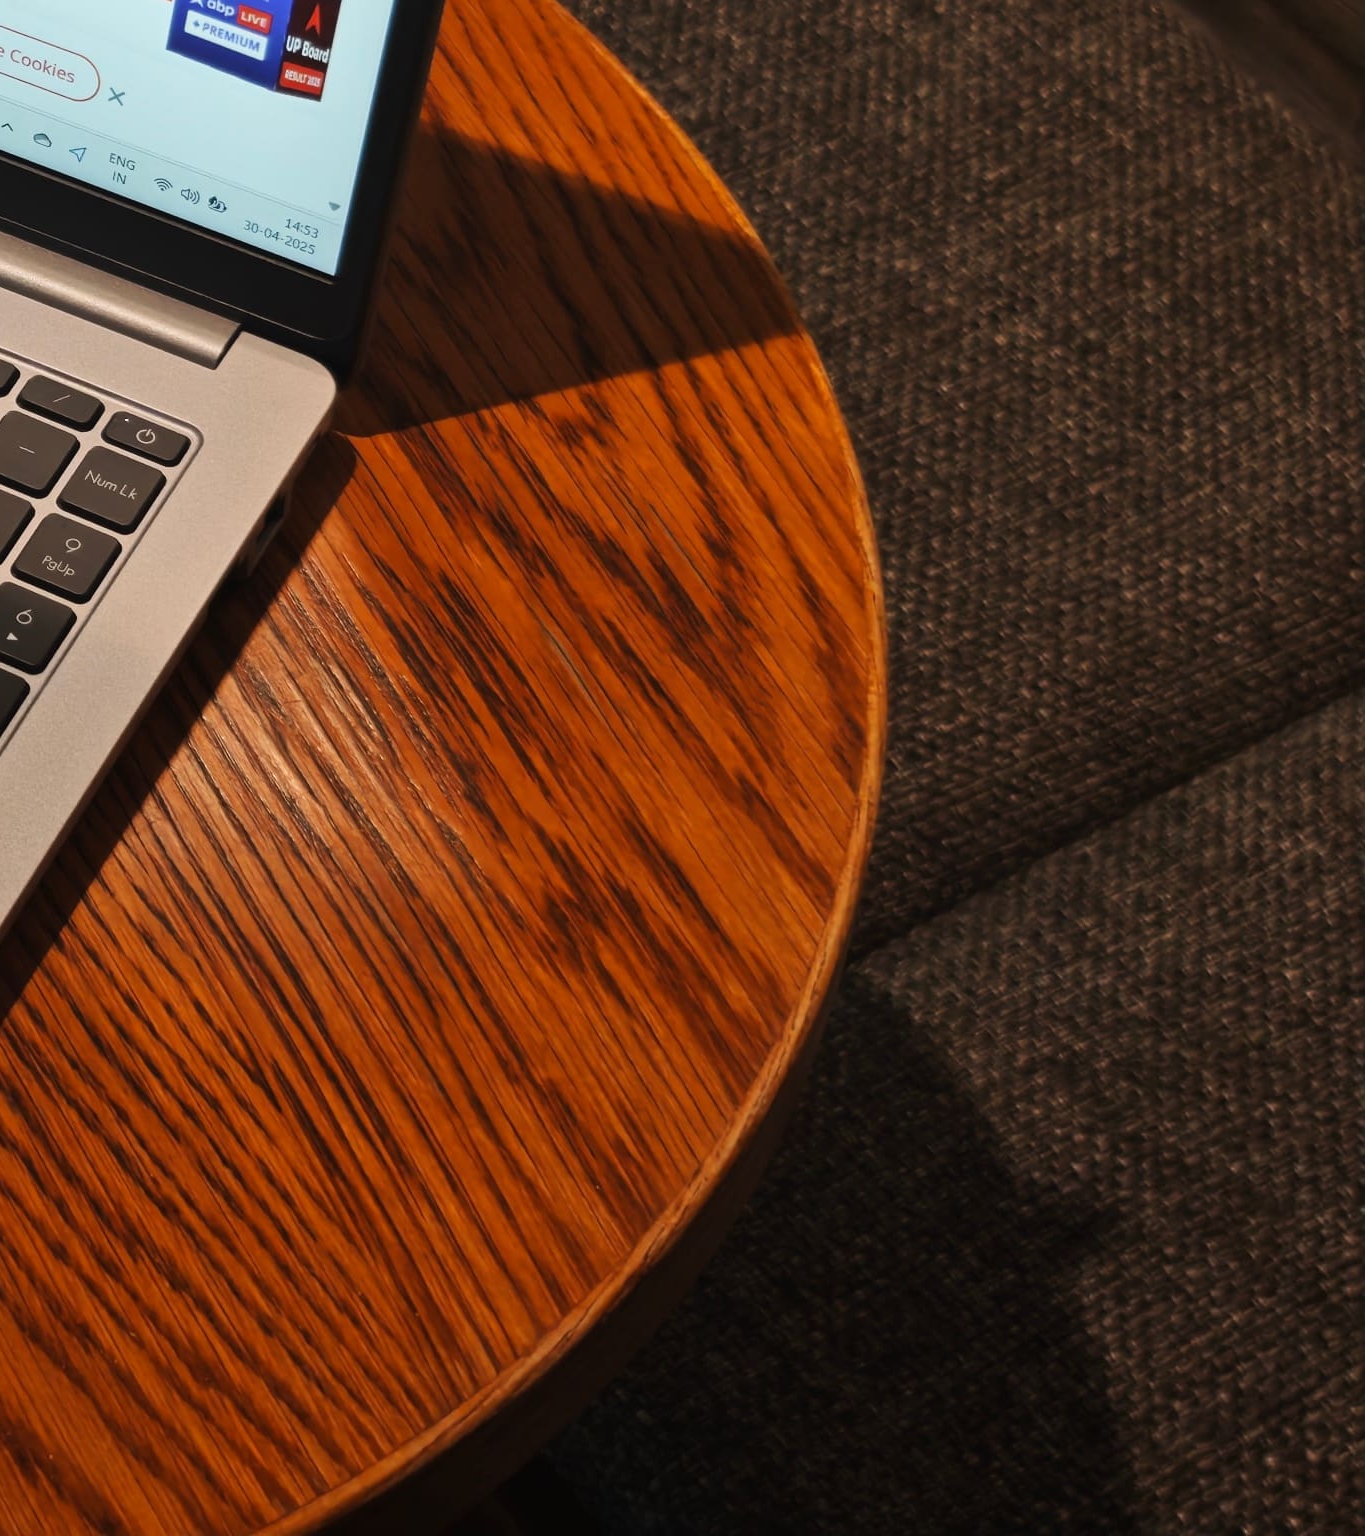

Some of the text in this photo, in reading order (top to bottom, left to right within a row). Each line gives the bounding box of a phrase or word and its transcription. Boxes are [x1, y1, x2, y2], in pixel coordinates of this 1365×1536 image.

[201, 22, 260, 51] PREMIUM
[9, 48, 74, 83] Cookies
[108, 152, 136, 171] ENG
[243, 219, 315, 255] 30-04-2025
[284, 218, 319, 239] 14:53
[41, 554, 75, 576] PgUp
